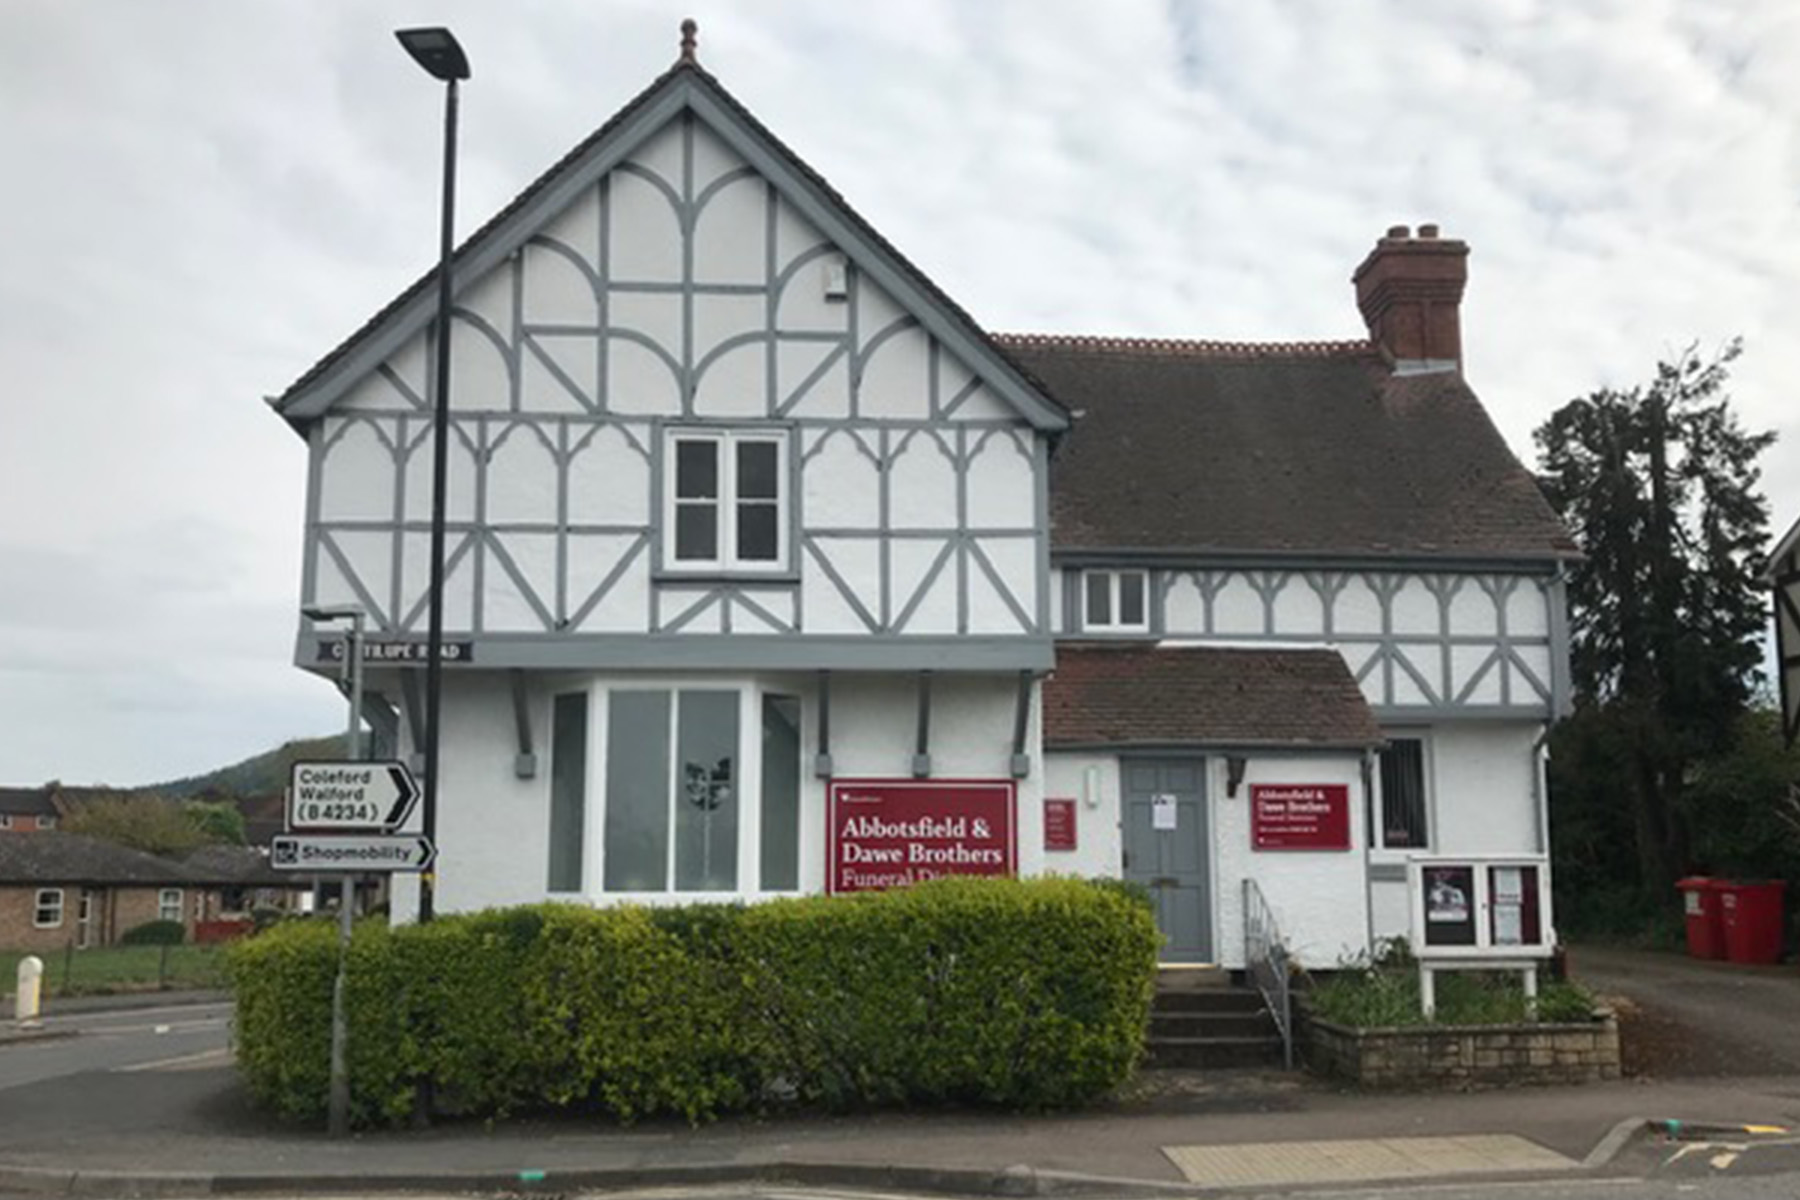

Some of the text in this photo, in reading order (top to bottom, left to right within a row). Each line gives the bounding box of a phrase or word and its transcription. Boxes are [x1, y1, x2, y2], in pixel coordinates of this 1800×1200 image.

[331, 643, 460, 659] CTILUPE RAD
[299, 769, 372, 784] Coleford
[299, 786, 365, 800] Walford
[841, 816, 992, 838] Abbotsfield &
[301, 845, 412, 862] Shopmobility
[841, 843, 1003, 863] Dawe Brothers
[841, 867, 914, 887] Funeral
